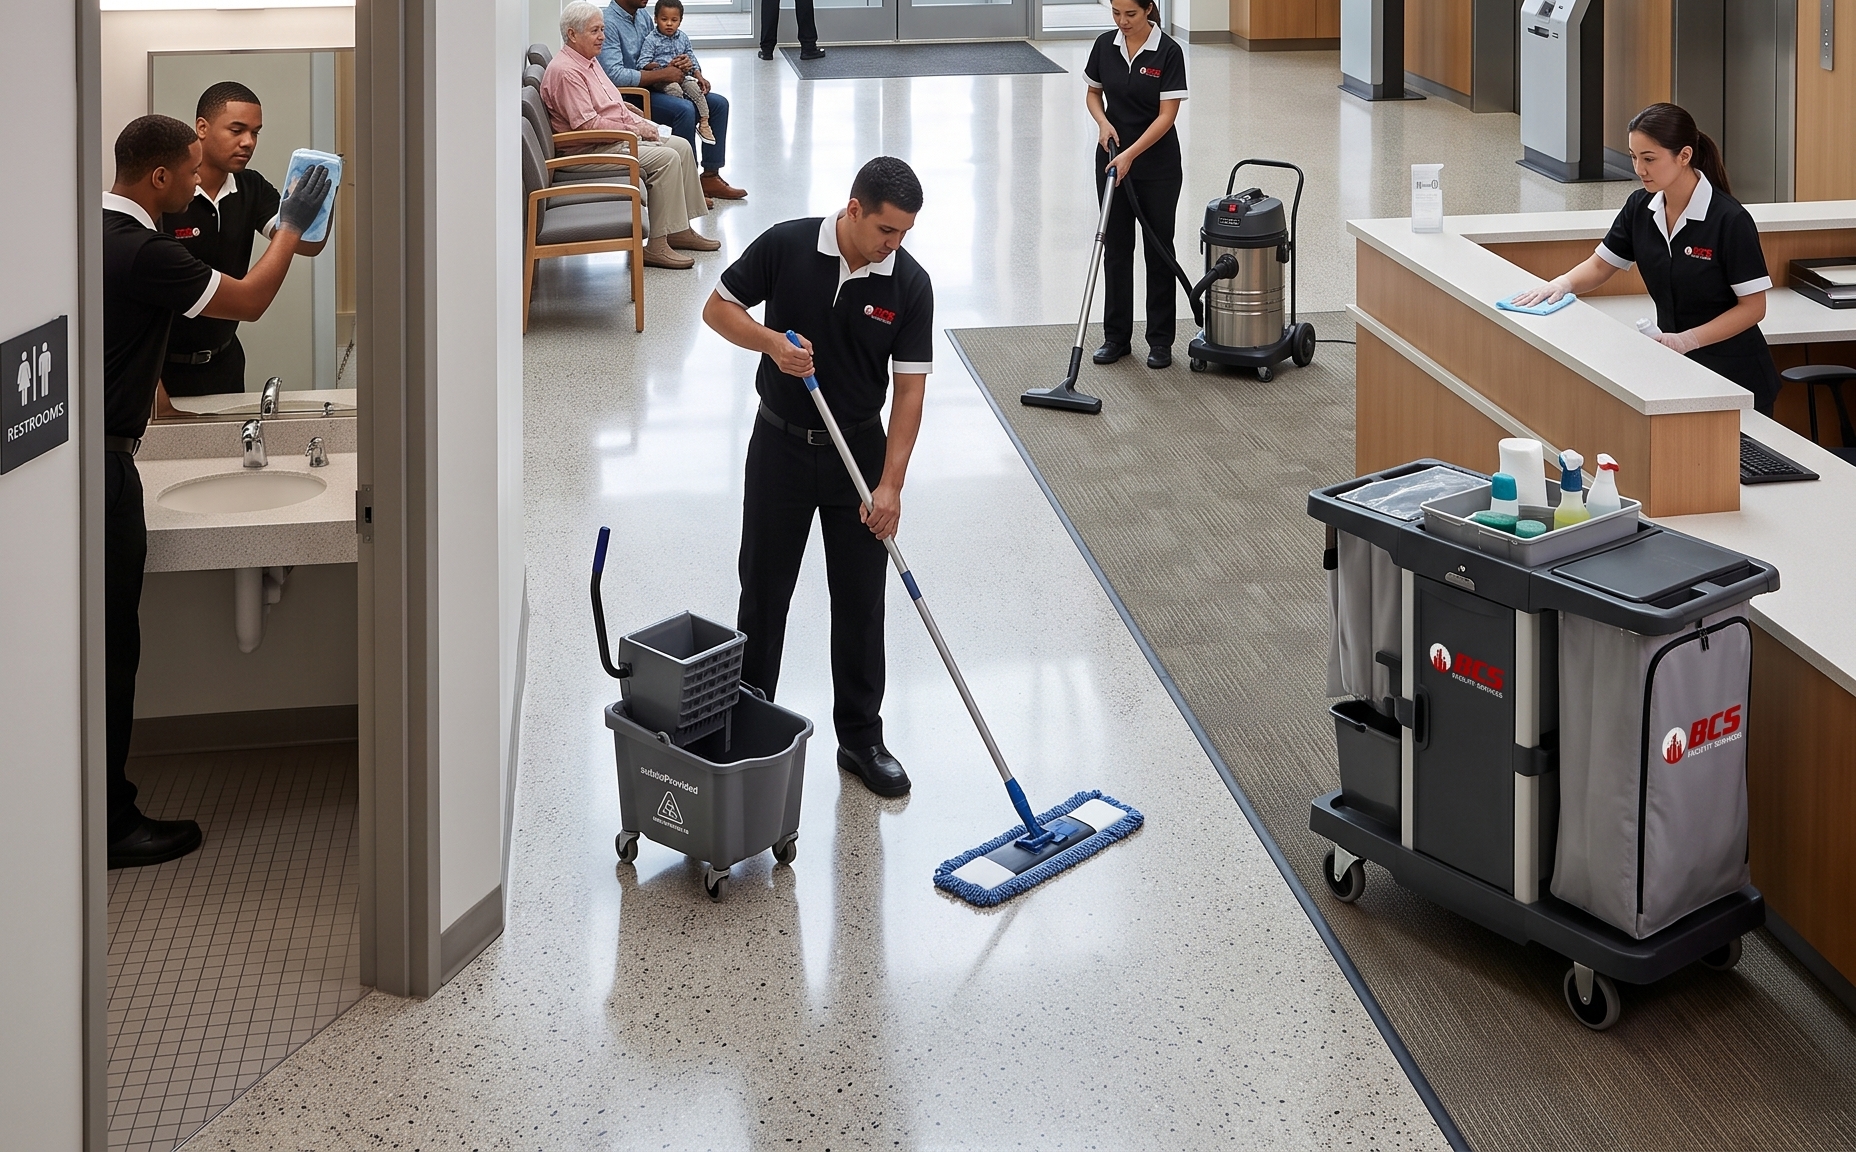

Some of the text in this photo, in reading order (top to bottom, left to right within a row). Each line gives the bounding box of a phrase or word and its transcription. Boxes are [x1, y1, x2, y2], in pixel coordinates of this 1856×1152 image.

[7, 402, 65, 443] RESTROOMS
[1453, 652, 1505, 691] BCS
[1687, 704, 1742, 750] BCS
